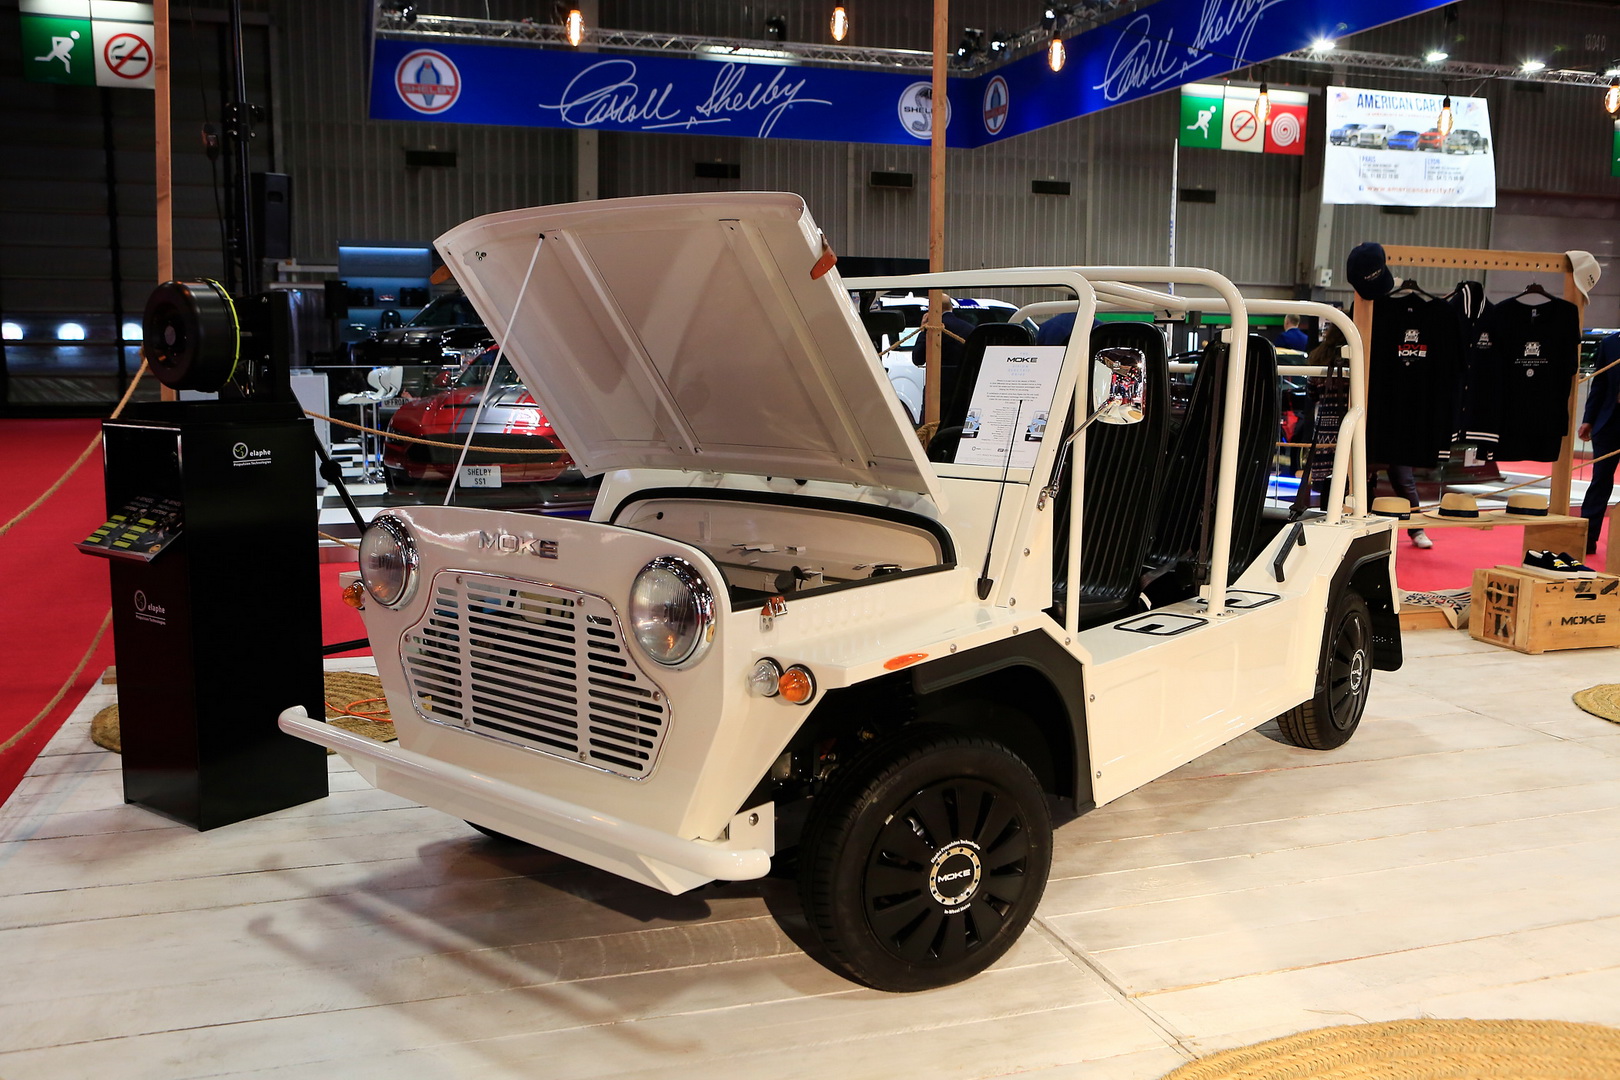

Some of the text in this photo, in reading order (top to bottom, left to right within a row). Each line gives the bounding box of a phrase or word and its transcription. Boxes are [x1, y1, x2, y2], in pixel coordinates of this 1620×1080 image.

[696, 62, 833, 138] Shelby
[1356, 93, 1413, 111] AMERICAN
[1416, 98, 1436, 113] CAR
[904, 106, 932, 114] SHEL
[1398, 343, 1428, 351] LOVE
[249, 449, 272, 457] elaphe
[467, 468, 492, 476] SHELBY
[479, 529, 559, 560] MOKE
[147, 603, 166, 614] elaphe
[1560, 614, 1607, 626] MOKE
[938, 869, 971, 882] MOKE
